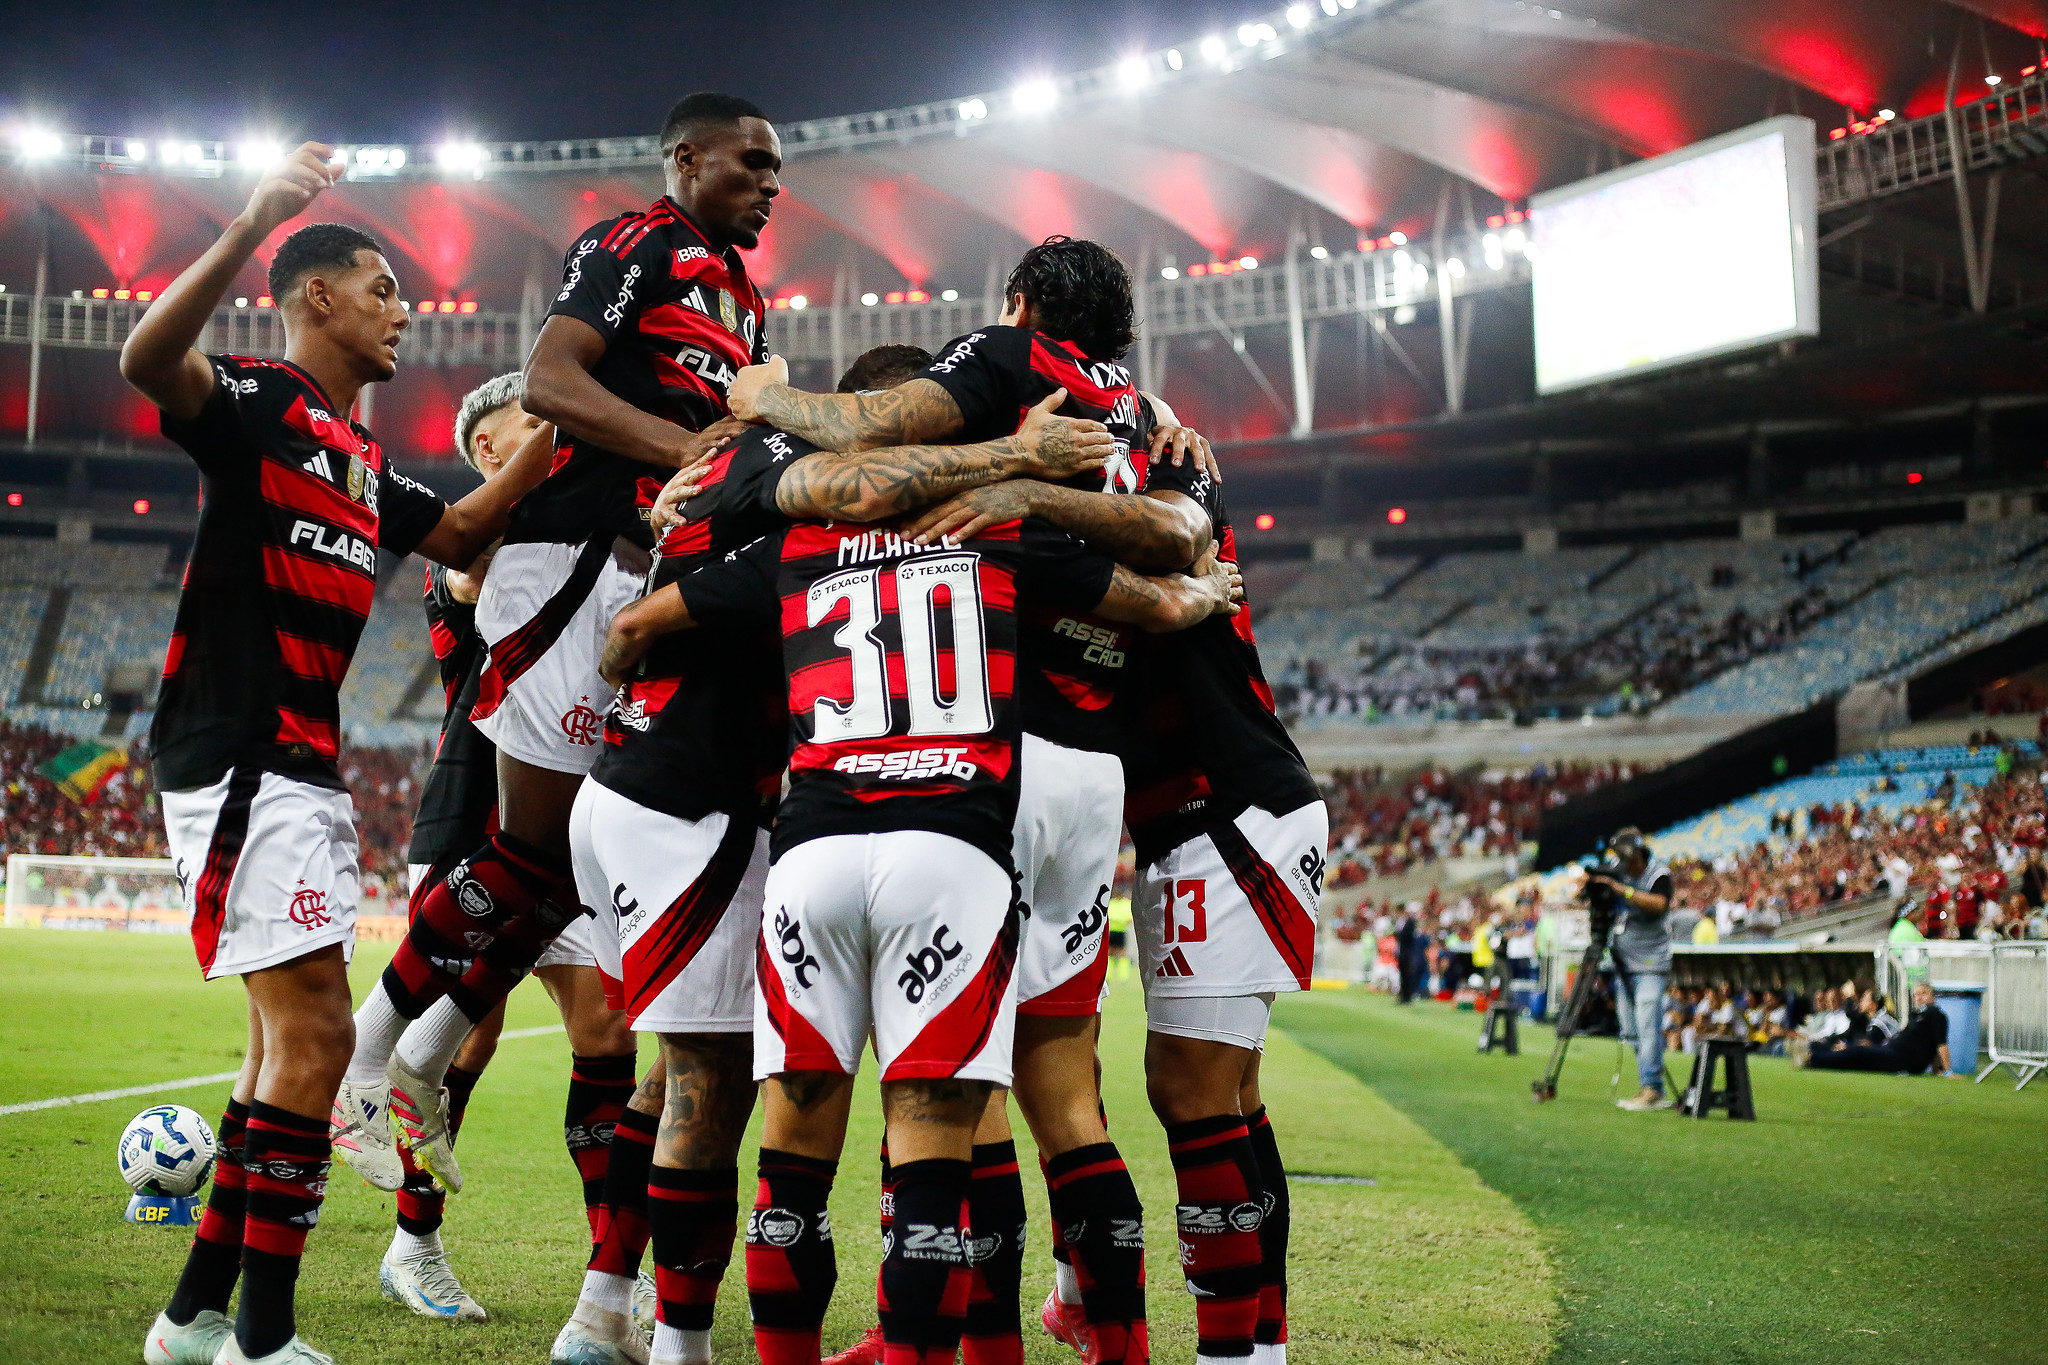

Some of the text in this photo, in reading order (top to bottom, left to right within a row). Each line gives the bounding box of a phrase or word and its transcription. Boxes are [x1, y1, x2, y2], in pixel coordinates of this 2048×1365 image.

[557, 238, 598, 302] Shopee
[290, 519, 377, 576] FLABET
[825, 575, 869, 594] TEXACO
[918, 563, 970, 577] TEXACO
[806, 551, 996, 744] 30
[833, 747, 969, 774] ASSIST
[1299, 845, 1326, 896] ab
[1163, 879, 1207, 943] 13
[774, 904, 821, 989] abc
[1070, 953, 1084, 966] da
[897, 923, 963, 1004] abc
[135, 1206, 171, 1222] CBF
[1177, 1205, 1227, 1228] Zé
[903, 1224, 962, 1254] Zé
[902, 1250, 963, 1264] DELIVERY
